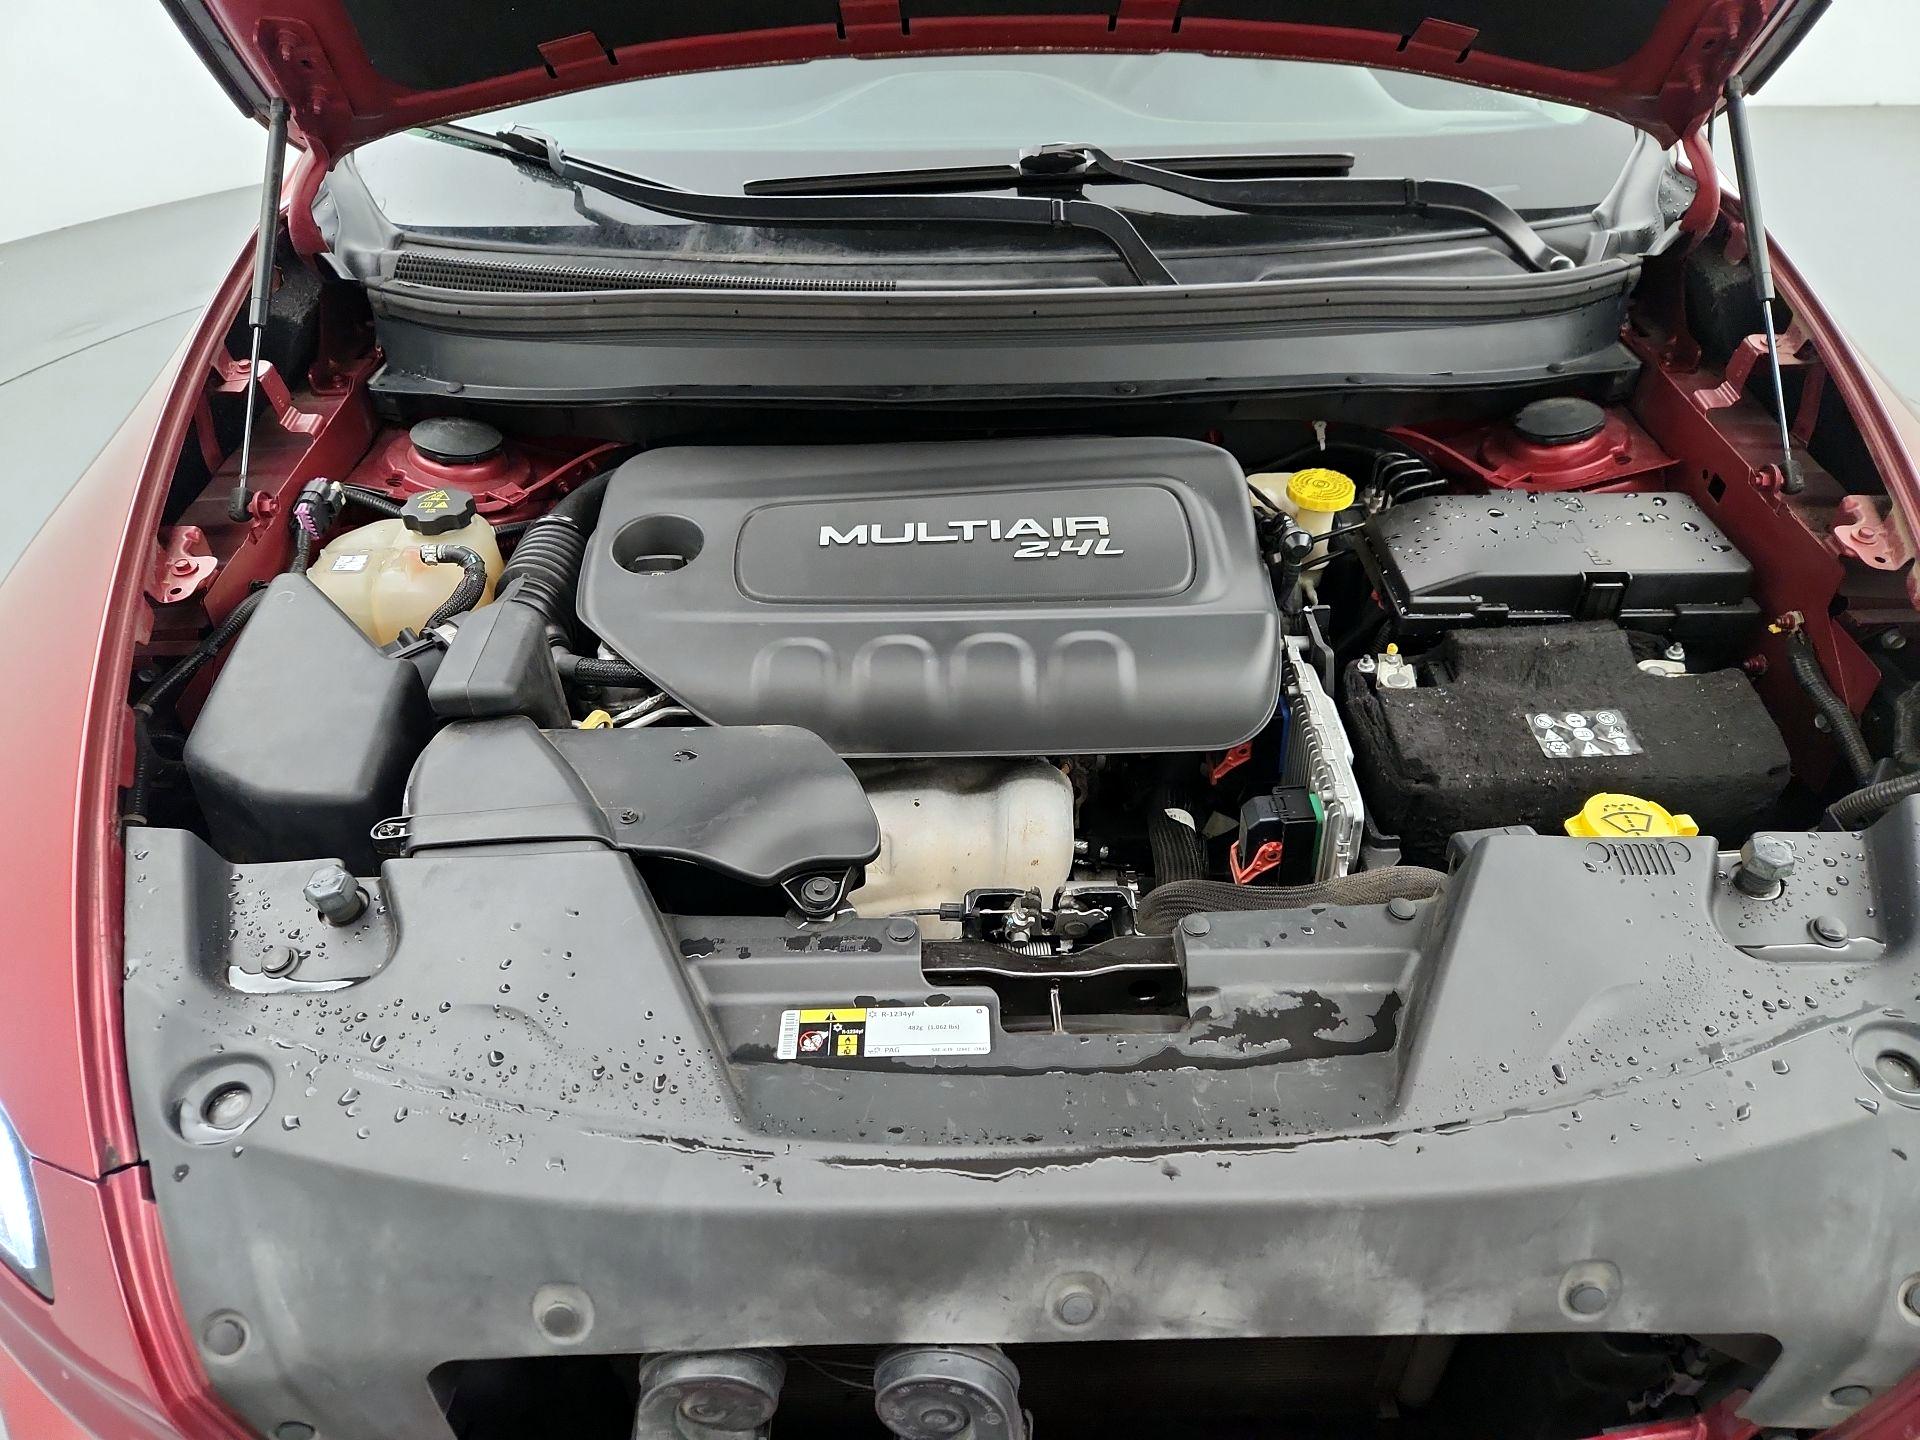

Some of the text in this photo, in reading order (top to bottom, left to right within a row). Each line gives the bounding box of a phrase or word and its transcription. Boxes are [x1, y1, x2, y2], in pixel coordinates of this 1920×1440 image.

[819, 516, 1110, 546] MULTIAIR
[1013, 538, 1124, 559] 2.4L
[881, 1010, 915, 1018] R-1234yf
